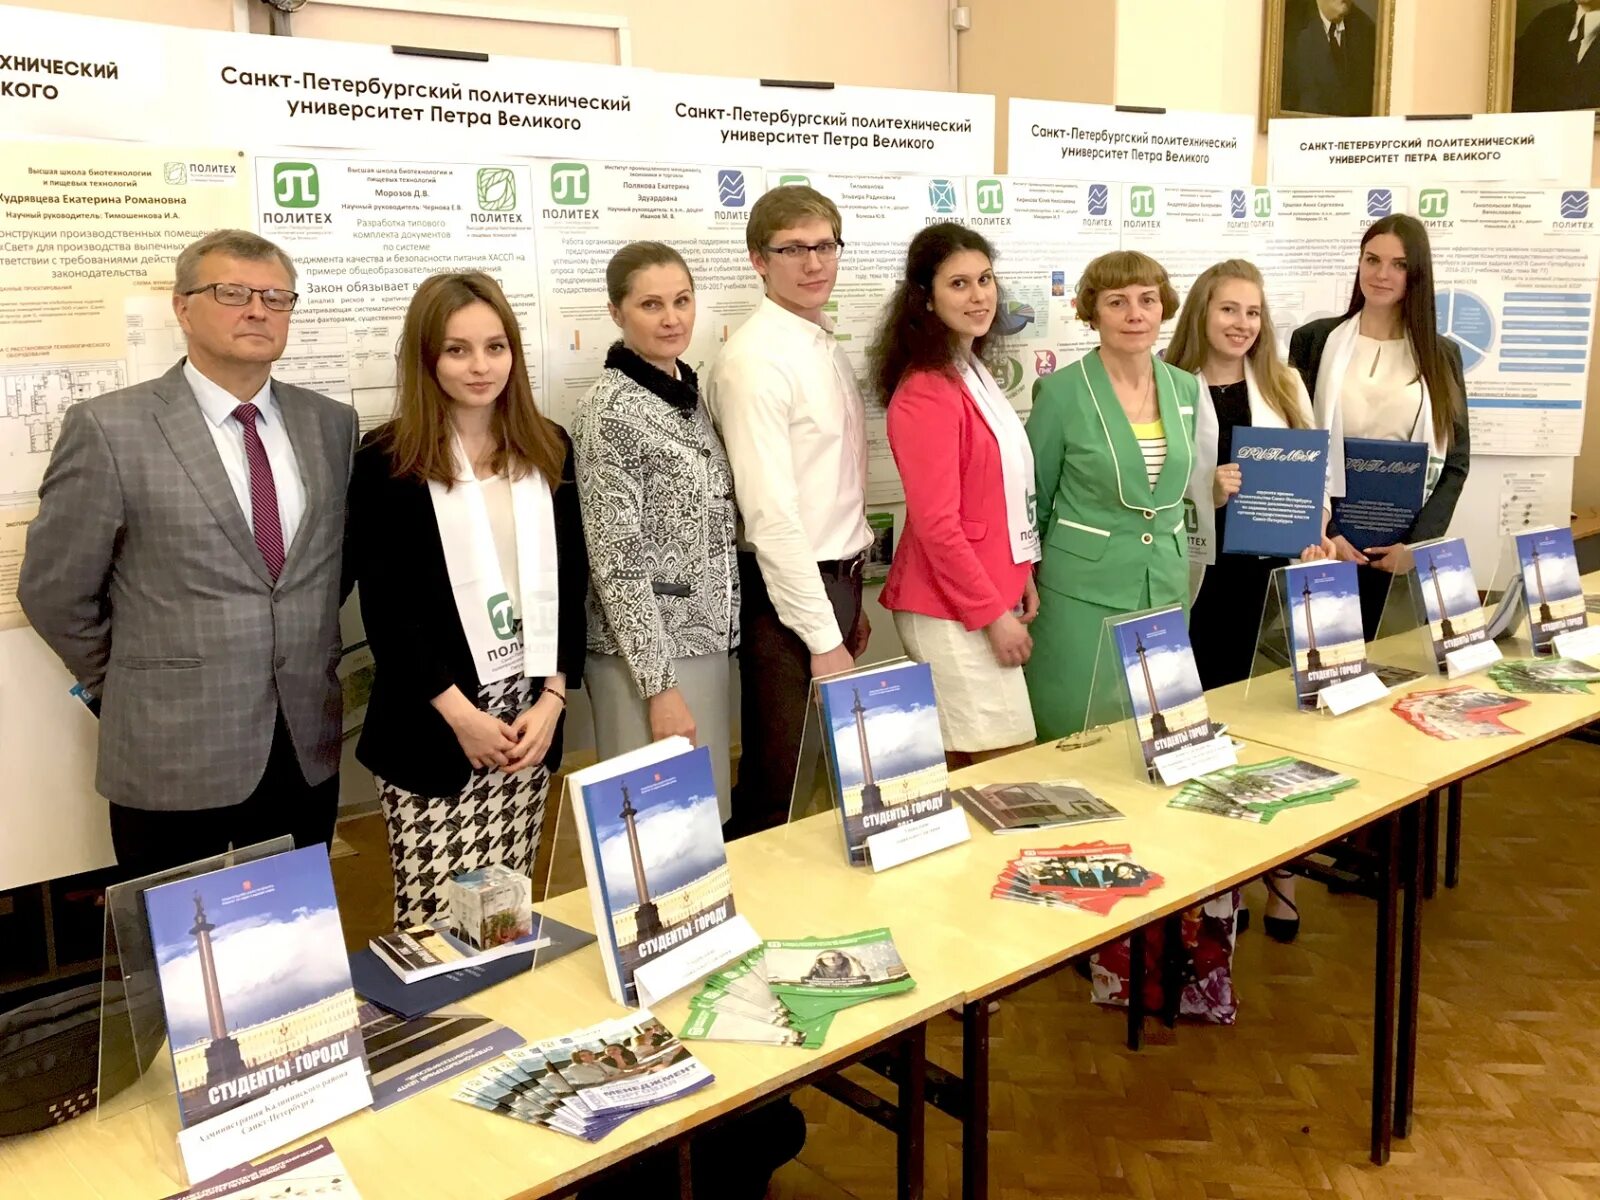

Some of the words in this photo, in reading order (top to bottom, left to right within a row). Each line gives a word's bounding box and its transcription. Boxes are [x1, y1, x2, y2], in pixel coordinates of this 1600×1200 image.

[1, 81, 59, 100] КОГО
[221, 66, 462, 99] Санкт-Петербургский
[468, 87, 631, 112] политехнический
[287, 98, 424, 122] университет
[431, 106, 491, 127] Петра
[498, 110, 582, 131] Великого
[675, 103, 847, 126] Санкт-Петербургский
[852, 116, 972, 133] политехнический
[720, 127, 819, 145] университет
[824, 132, 868, 149] Петра
[874, 135, 934, 150] Великого
[1031, 124, 1148, 144] Санкт-Петербургский
[1151, 135, 1237, 149] политехнический
[1300, 138, 1422, 151] САНКТ-ПЕТЕРБУРГСКИЙ
[1427, 135, 1535, 149] ПОЛИТЕХНИЧЕСКИЙ
[1061, 146, 1128, 160] университет
[1132, 148, 1162, 163] Петра
[1166, 150, 1210, 164] Великого
[1329, 153, 1399, 164] УНИВЕРСИТЕТ
[1404, 153, 1438, 162] ПЕТРА
[1443, 151, 1501, 162] ВЕЛИКОГО
[190, 164, 237, 174] ПОЛИТЕХ
[657, 182, 690, 191] Екатерина
[375, 190, 411, 198] Морозов
[412, 190, 430, 198] Д.В.
[62, 194, 122, 206] Екатерина
[124, 195, 187, 205] Романовна
[6, 211, 42, 220] Научный
[264, 213, 332, 224] ПОЛИТЕХ
[470, 214, 522, 223] ПОЛИТЕХ
[542, 208, 600, 220] ПОЛИТЕХ
[714, 211, 750, 220] ПОЛИТЕ
[357, 218, 406, 230] Разработка
[971, 217, 1012, 226] ПОЛИТЕХ
[1083, 218, 1112, 227] ПОЛИТЕХ
[1124, 220, 1160, 229] ПОЛИТЕХ
[60, 230, 161, 240] производственных
[353, 231, 400, 240] комплекта
[401, 231, 451, 240] документов
[36, 243, 54, 252] для
[57, 242, 132, 252] производства
[60, 256, 139, 266] требованиями
[346, 256, 384, 264] качества
[394, 254, 452, 264] безопасности
[52, 268, 148, 279] законодательства
[306, 282, 343, 294] Закон
[346, 282, 408, 293] обязывает
[603, 1063, 696, 1096] МЕНЕДЖМЕНТ
